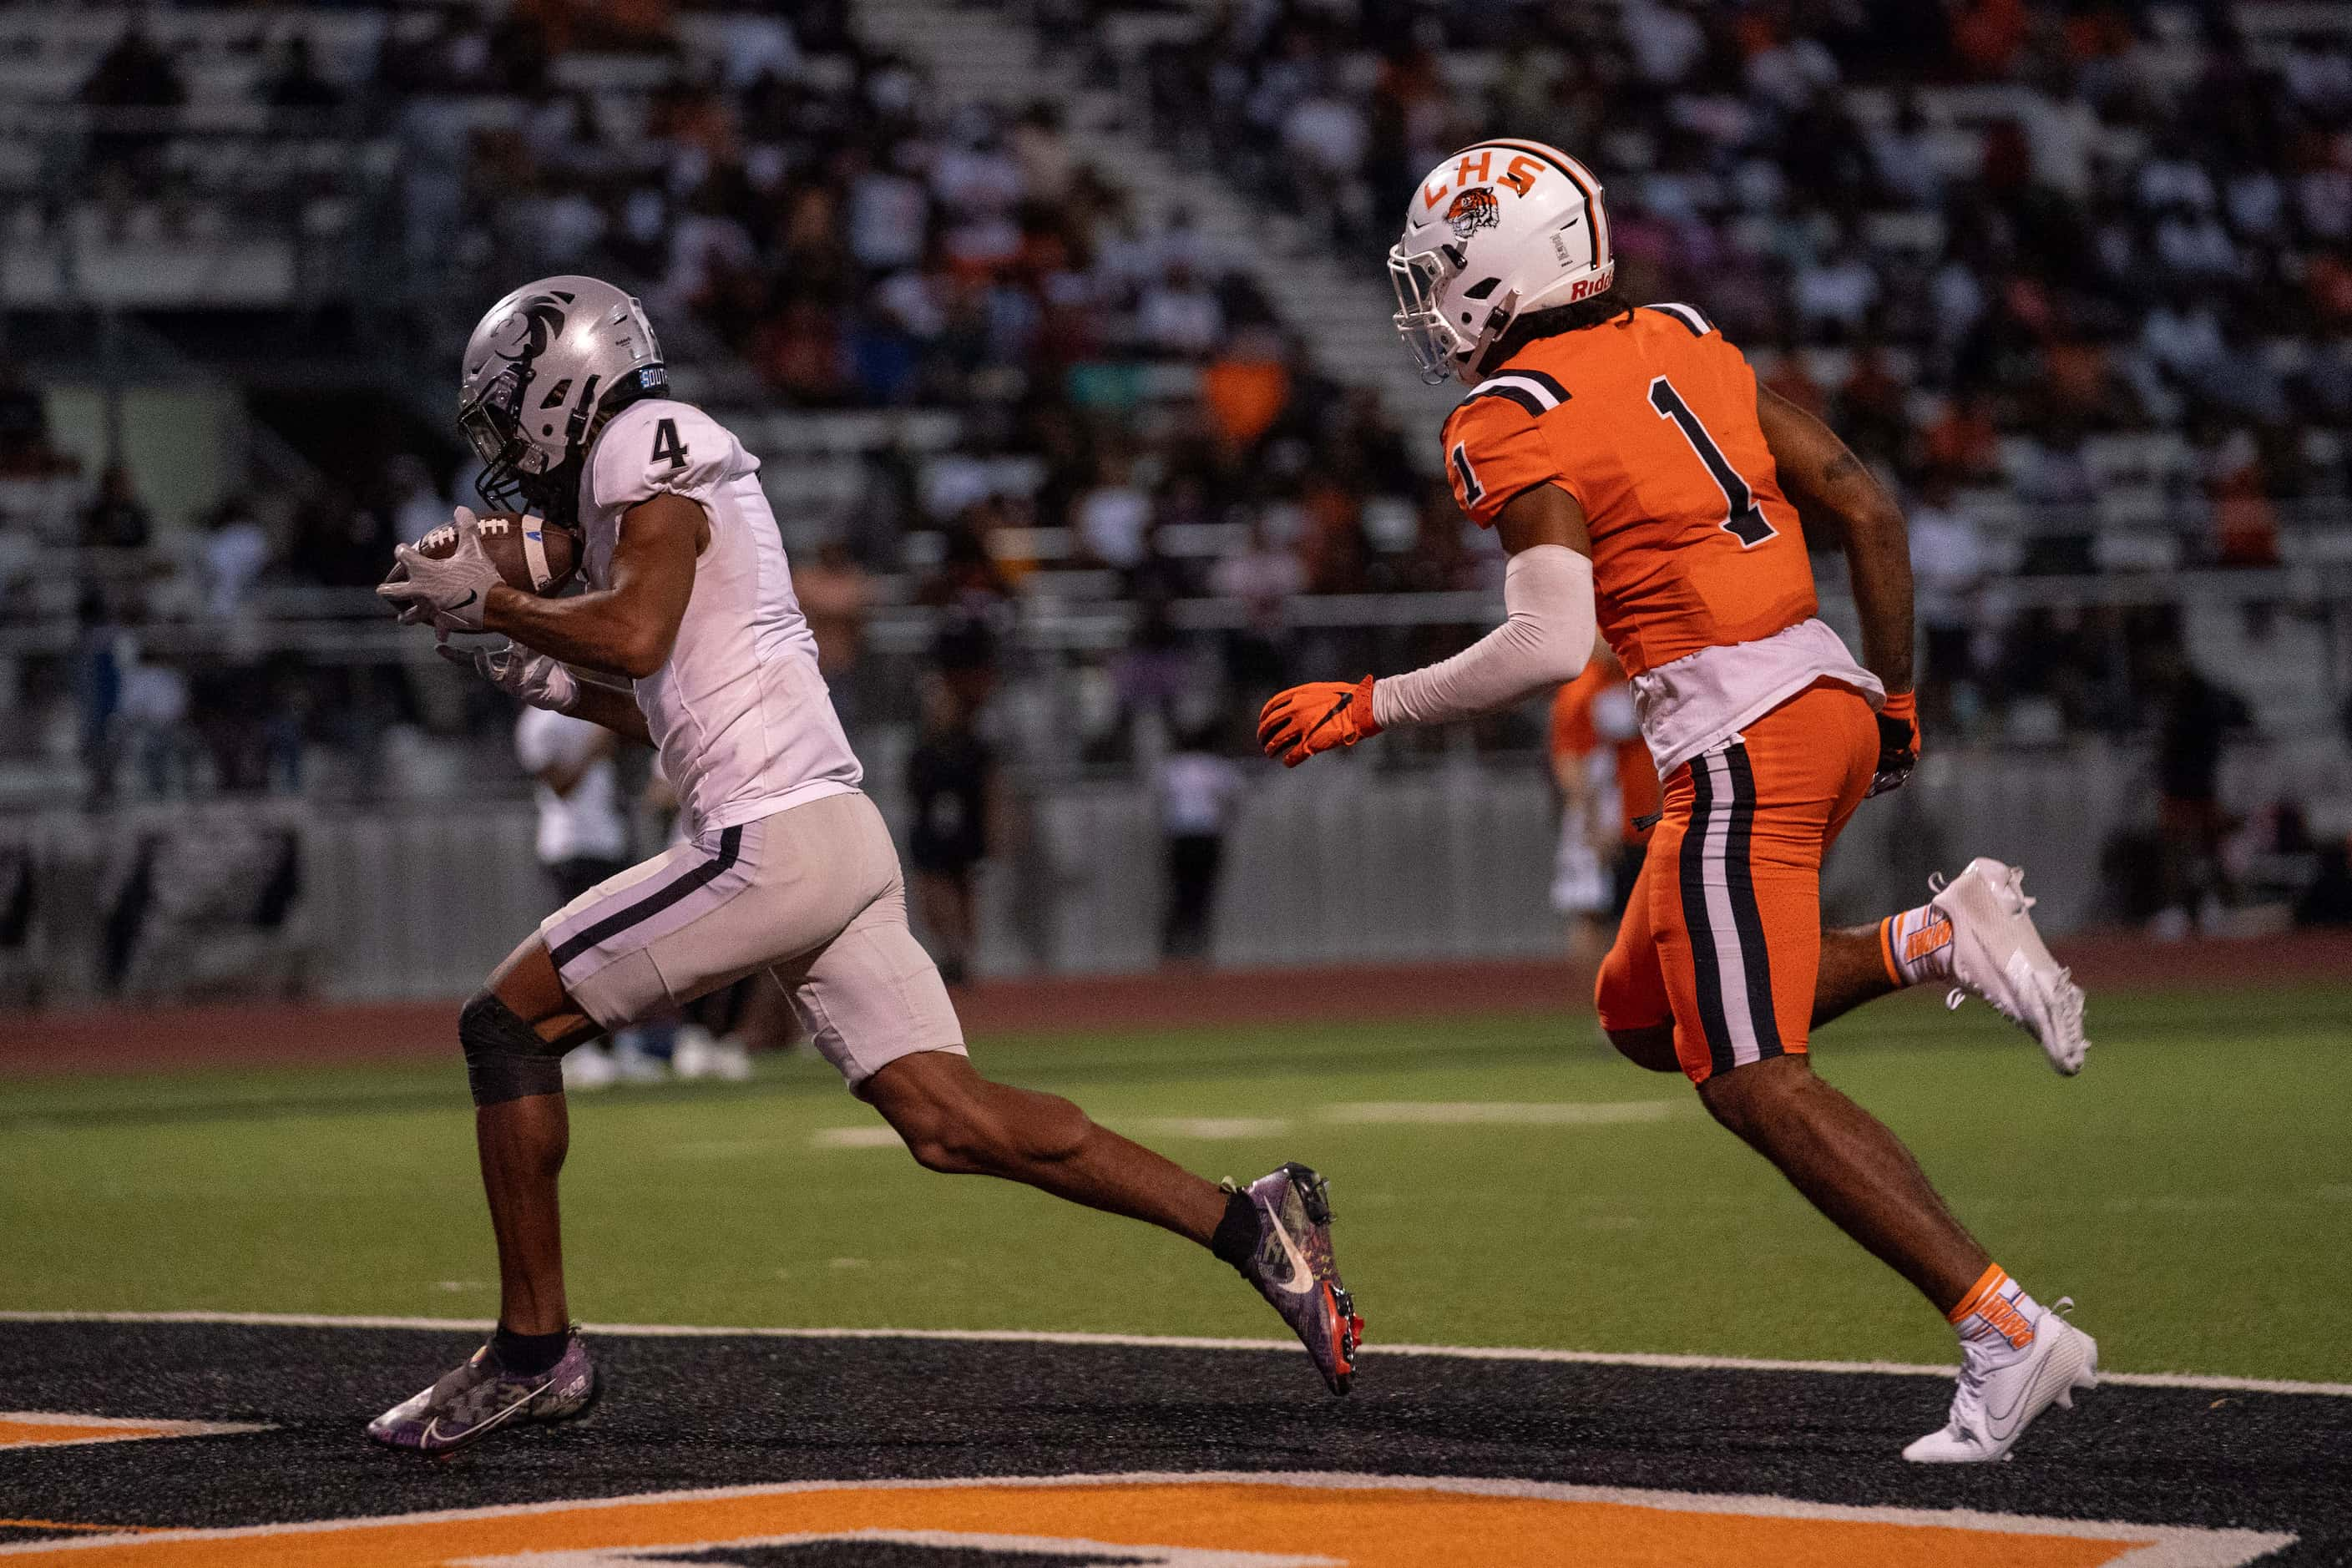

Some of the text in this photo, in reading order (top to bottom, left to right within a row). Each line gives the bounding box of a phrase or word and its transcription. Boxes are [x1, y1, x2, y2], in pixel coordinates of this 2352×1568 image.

[1424, 151, 1546, 210] LHS
[1571, 269, 1613, 301] Ridd
[650, 417, 689, 470] 4
[1646, 374, 1779, 549] 1
[1452, 440, 1486, 508] 1
